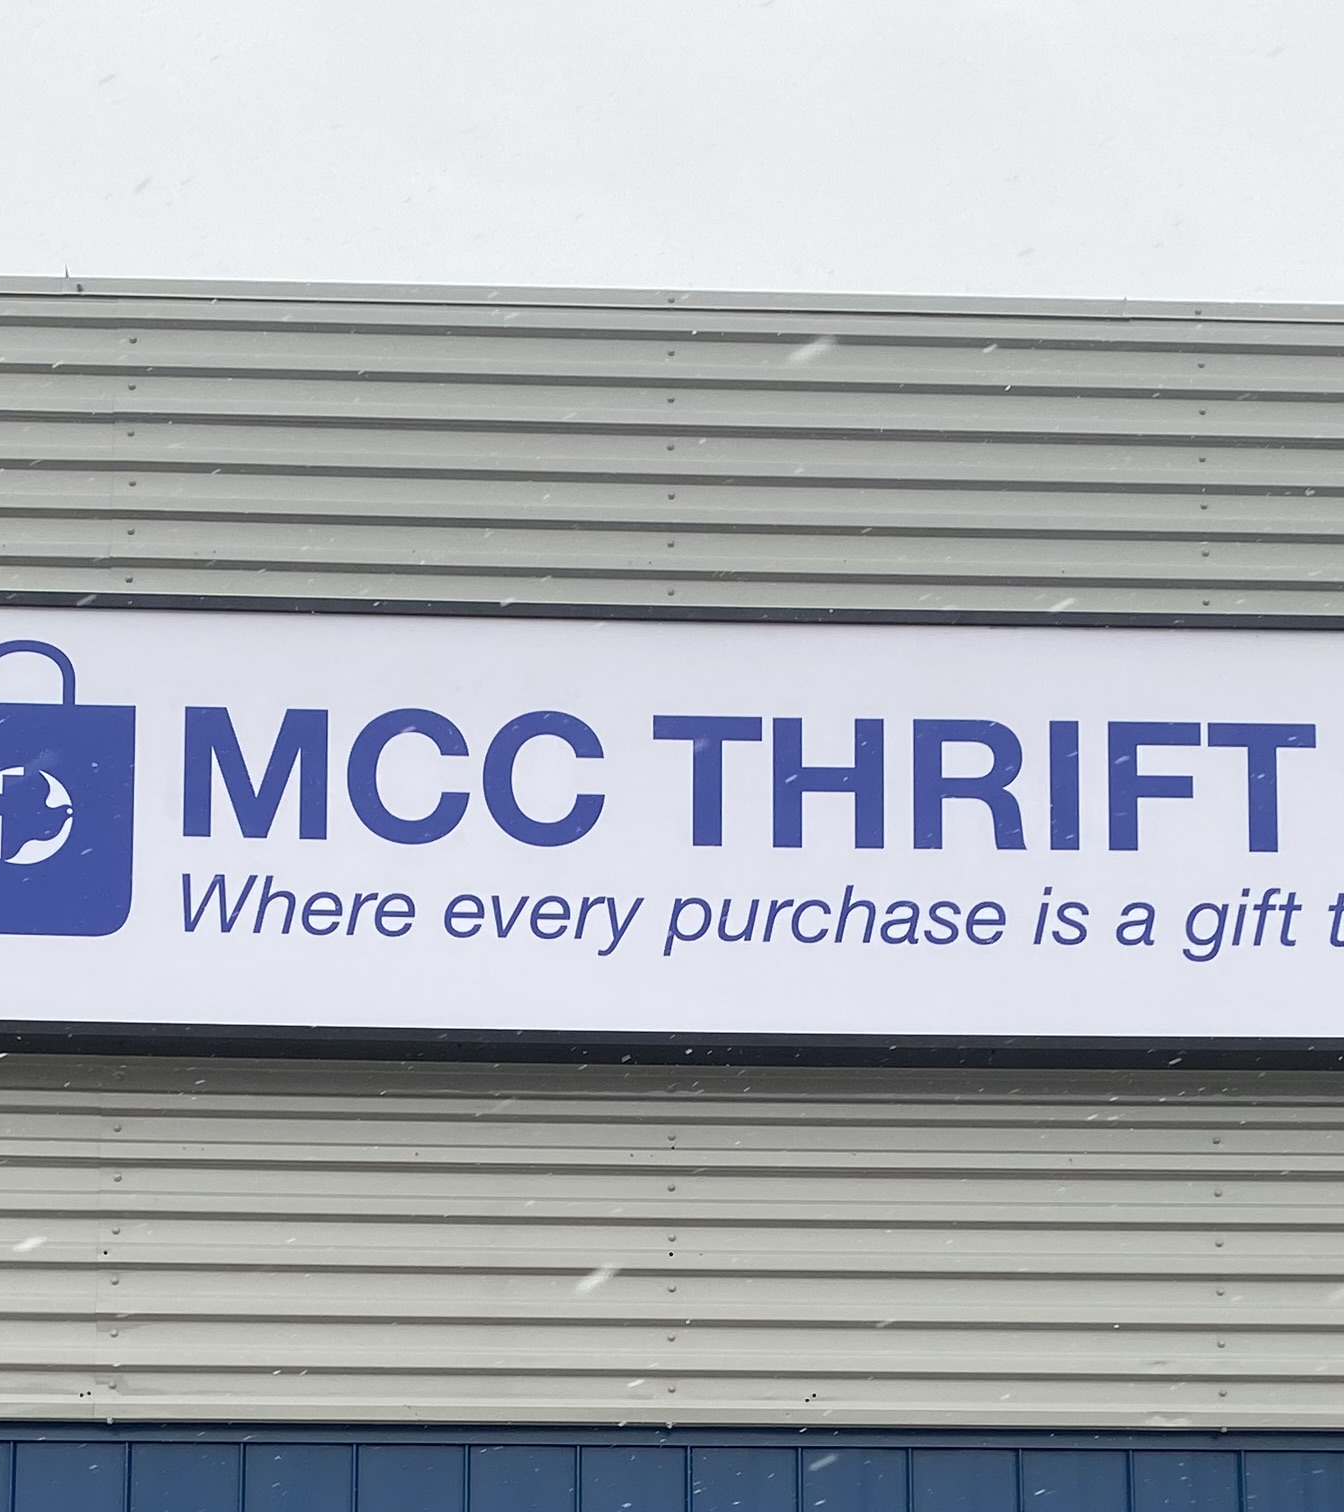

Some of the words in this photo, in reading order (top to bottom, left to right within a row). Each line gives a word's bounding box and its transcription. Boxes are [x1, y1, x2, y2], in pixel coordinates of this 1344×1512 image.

[182, 705, 605, 848] MCC
[653, 714, 1317, 853] THRIFT
[182, 873, 415, 937] Where
[444, 894, 643, 956] every
[664, 885, 1006, 955] purchase
[1034, 888, 1089, 946] is
[1116, 902, 1156, 946] a
[1183, 888, 1303, 962] gift
